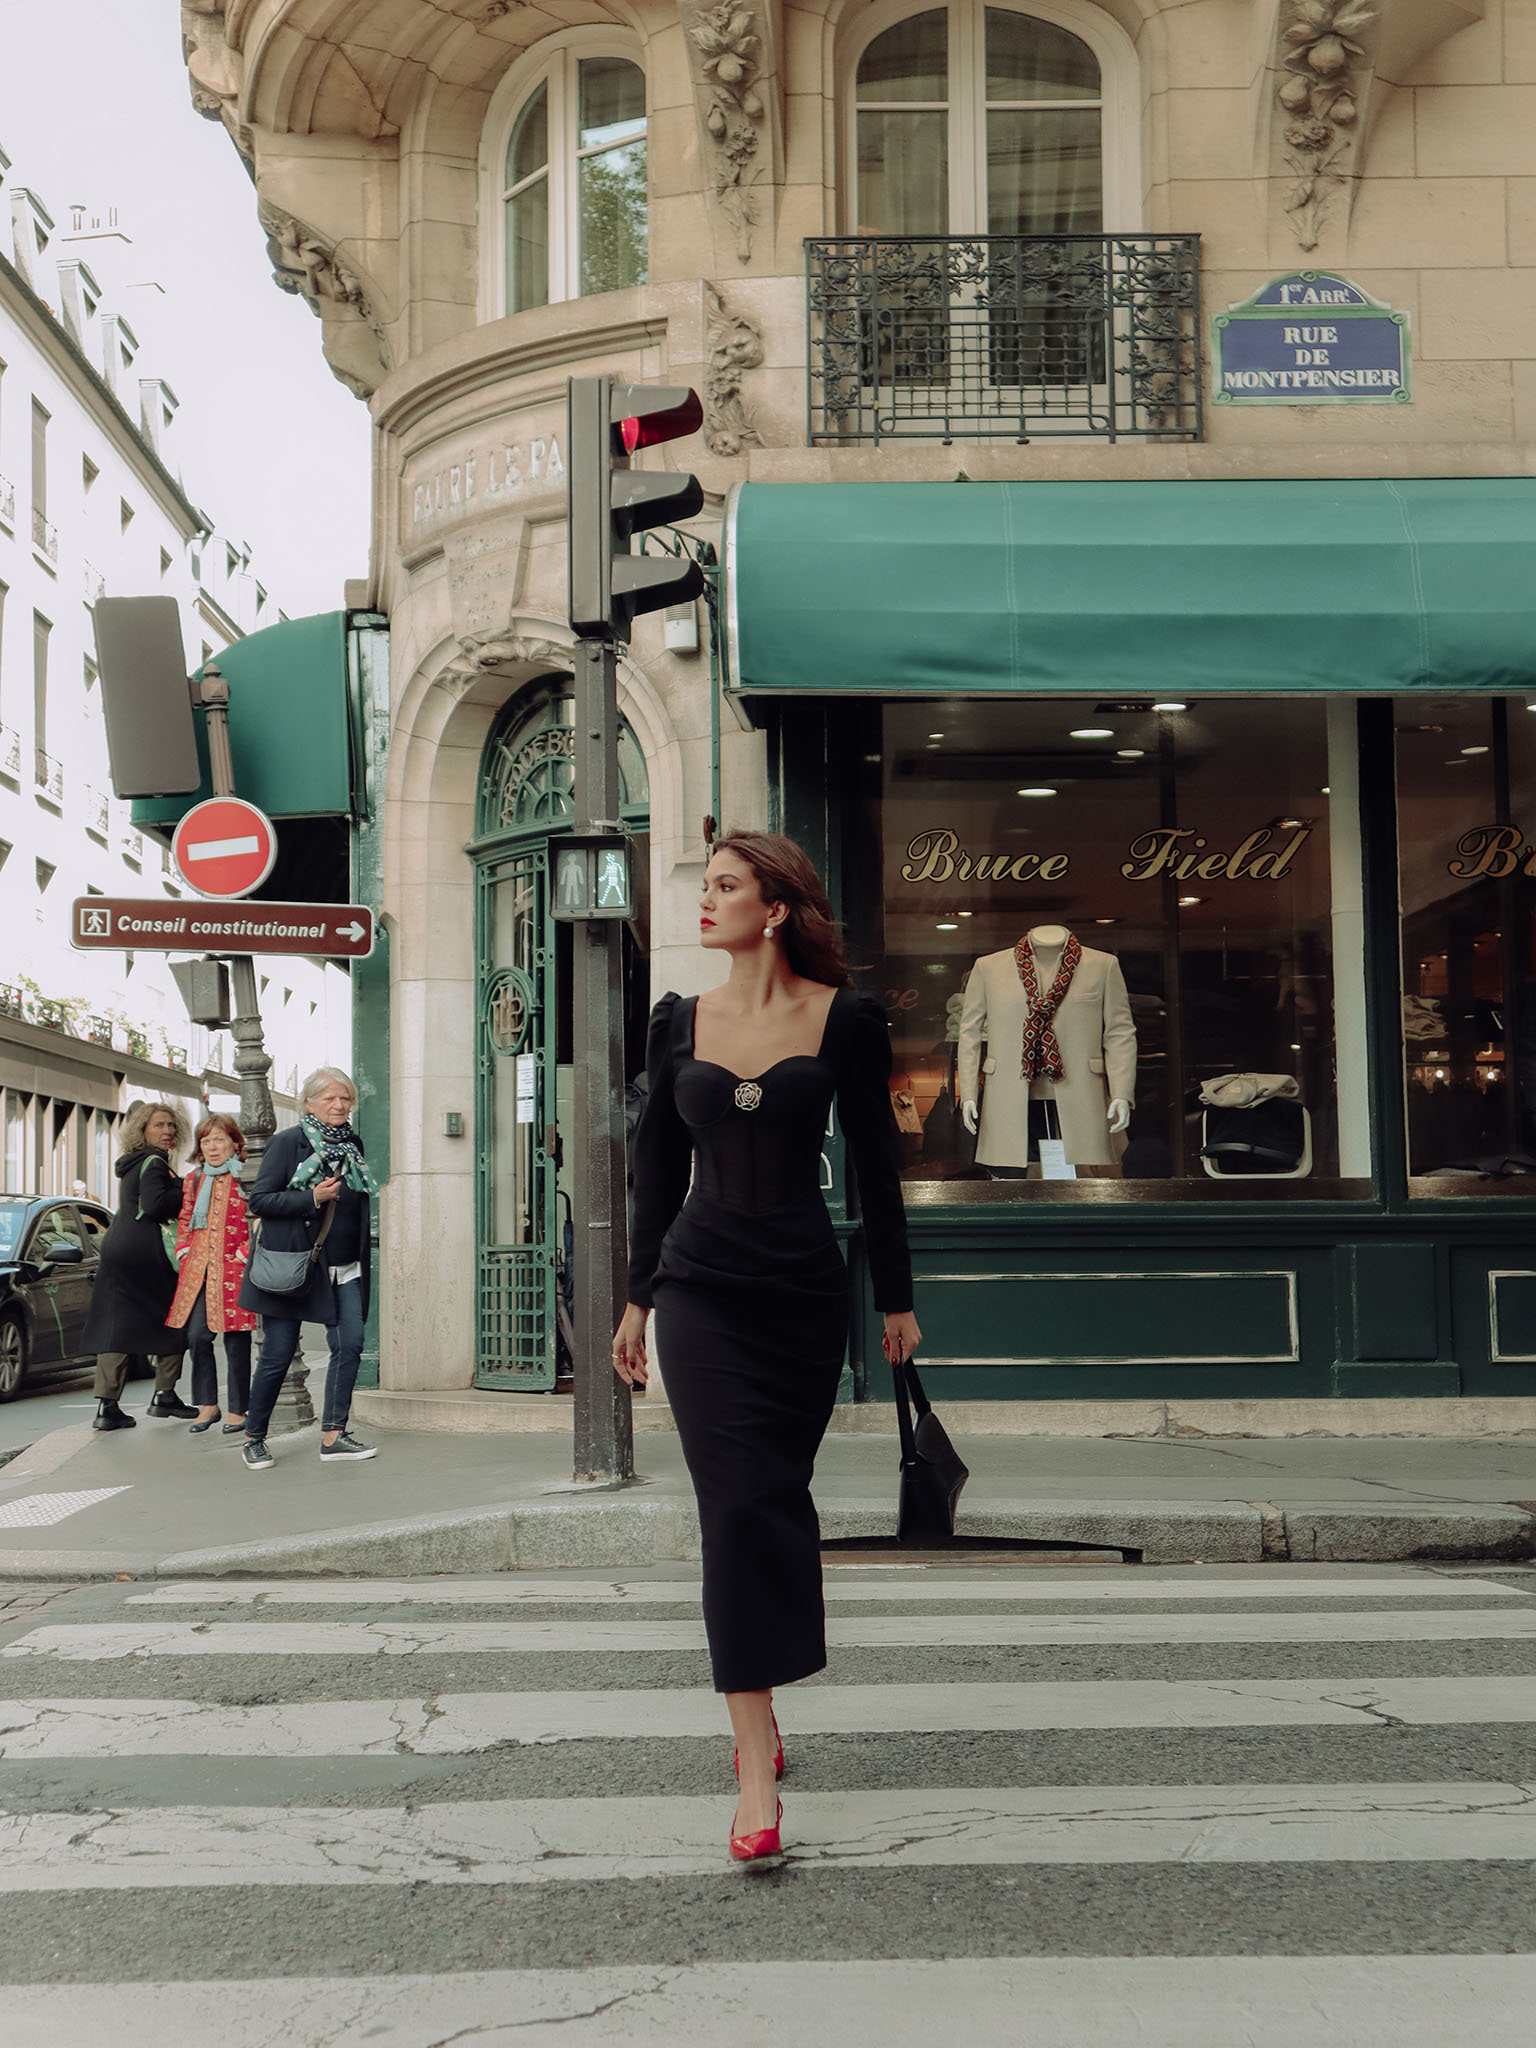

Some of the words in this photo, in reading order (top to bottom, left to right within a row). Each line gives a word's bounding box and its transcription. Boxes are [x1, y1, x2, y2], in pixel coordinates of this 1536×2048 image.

[1284, 326, 1338, 344] RUE
[1295, 349, 1330, 366] DE
[1223, 369, 1400, 389] MONTPENSIER
[901, 828, 1070, 882] Bruce
[1121, 828, 1312, 882] Field
[117, 915, 187, 934] Conseil
[190, 920, 326, 938] constitutionnel
